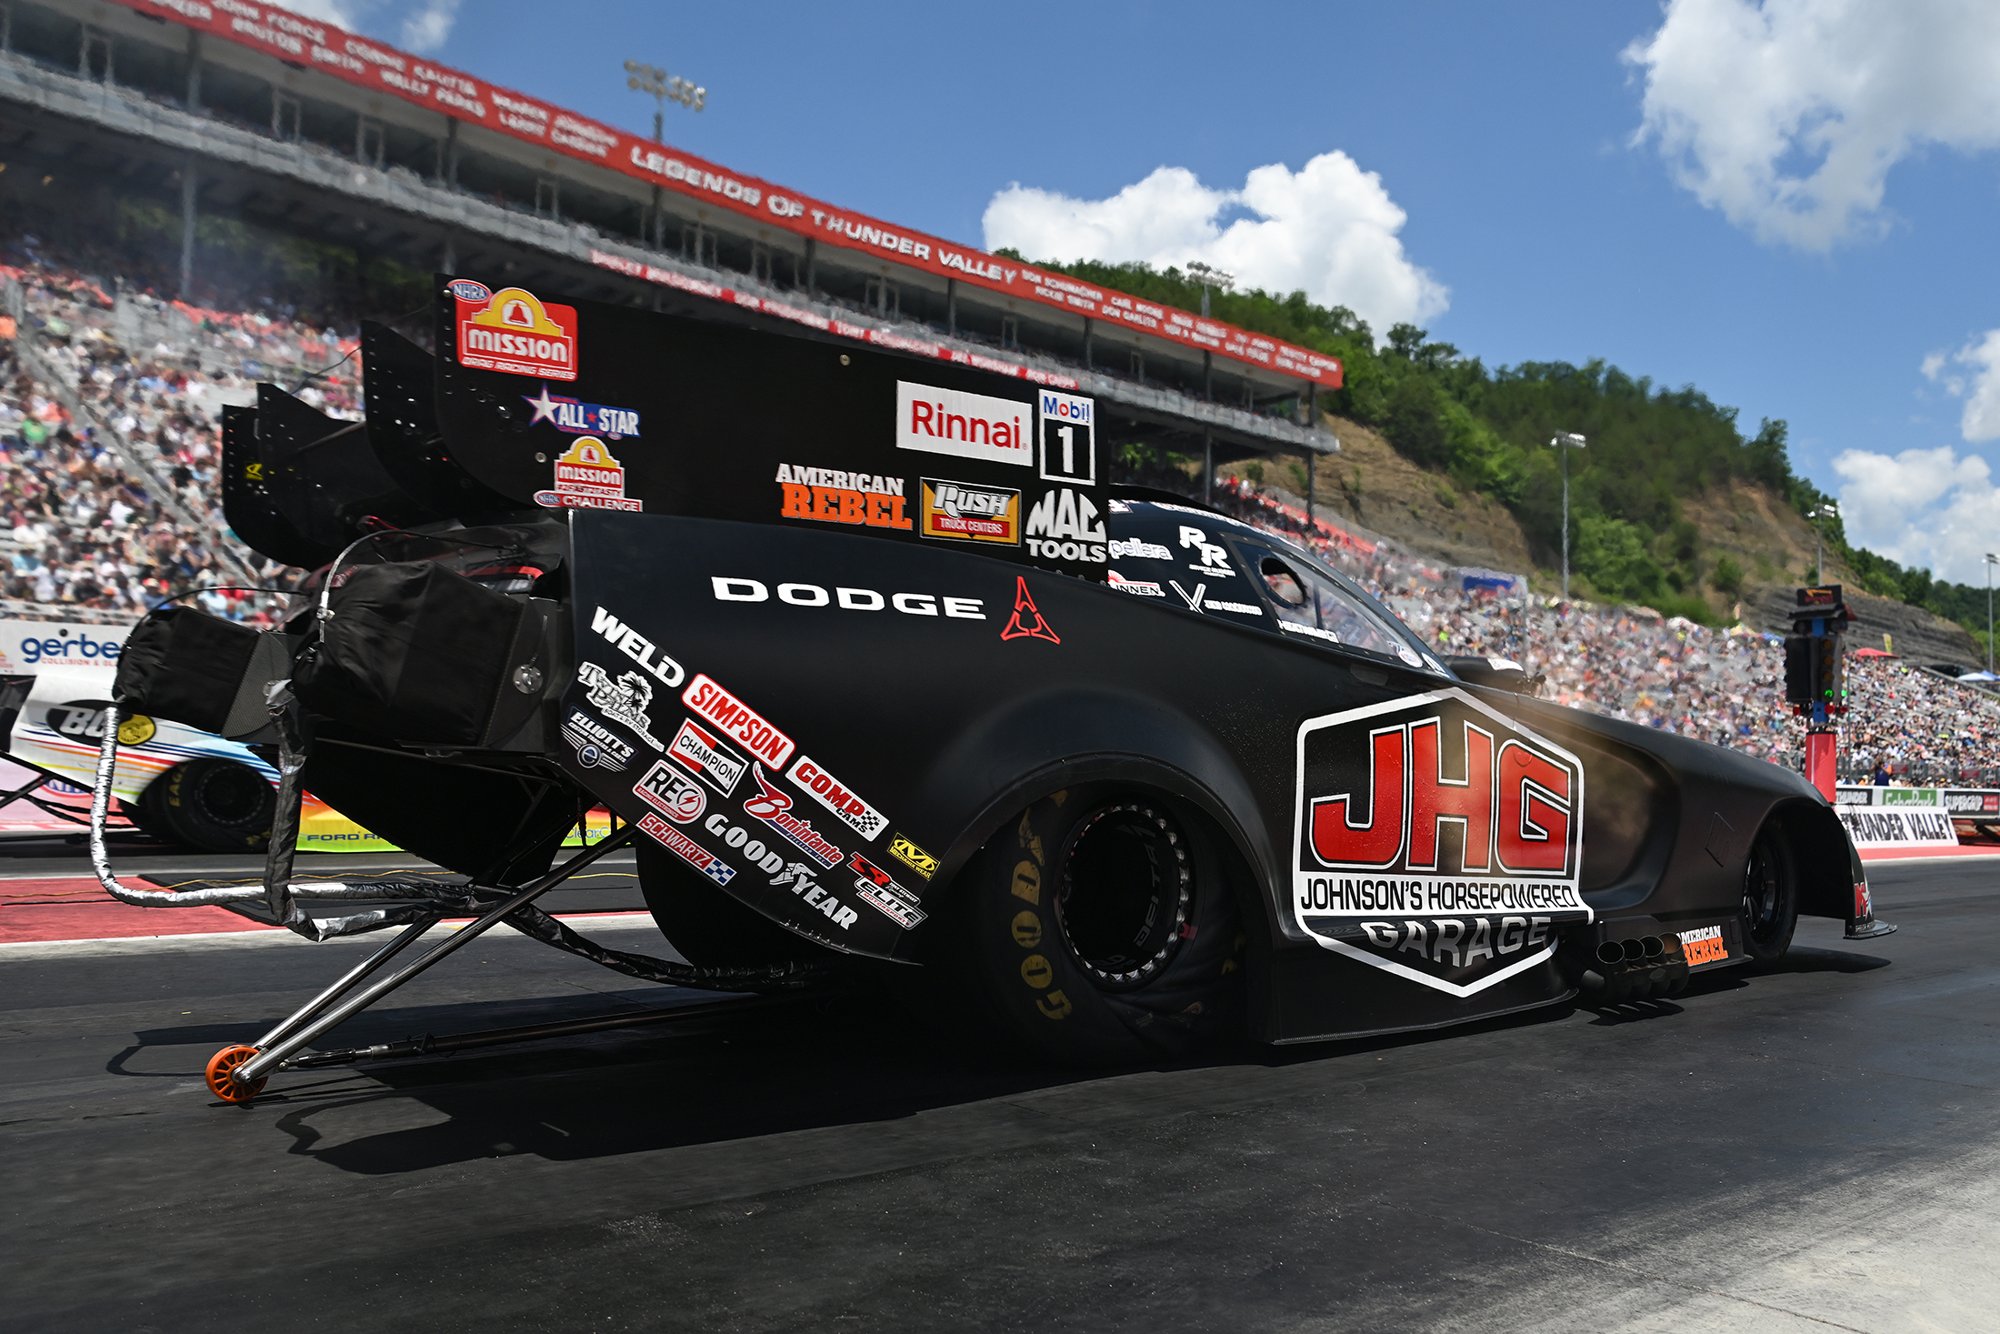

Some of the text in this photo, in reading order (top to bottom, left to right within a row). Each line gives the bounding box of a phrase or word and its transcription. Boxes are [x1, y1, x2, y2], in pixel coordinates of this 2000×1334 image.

[630, 146, 1017, 284] LEGENDS OF THUNDER VALLEY
[453, 284, 487, 299] NHRA
[461, 357, 577, 380] DRAG RACING SERIES
[558, 402, 640, 436] ALL STAR
[911, 399, 1020, 449] Rinnai
[1043, 395, 1090, 423] Mobil
[1057, 425, 1074, 474] 1
[775, 463, 904, 497] AMERICAN
[932, 483, 1011, 519] RUSH
[563, 495, 639, 513] CHALLENGE
[780, 482, 914, 531] REBEL
[939, 517, 1003, 535] TRUCK CENTERS
[1026, 488, 1107, 543] MAC
[1026, 539, 1107, 563] TOOLS
[711, 576, 986, 620] DODGE
[591, 606, 686, 688] WELD
[571, 711, 635, 758] ELLIOTT'S
[691, 683, 786, 763] SIMPSON
[680, 735, 736, 781] CHAMPION
[795, 761, 866, 817] COMP
[1310, 715, 1571, 876] JHG
[307, 834, 359, 842] FORD
[743, 770, 845, 864] Boninfante
[836, 807, 868, 834] CAMS
[1905, 813, 1953, 841] VALLEY
[641, 817, 711, 868] SCHWARTZ
[860, 881, 918, 924] ELITE
[1300, 878, 1579, 911] JOHNSON'S HORSEPOWERED
[1360, 916, 1552, 968] GARAGE
